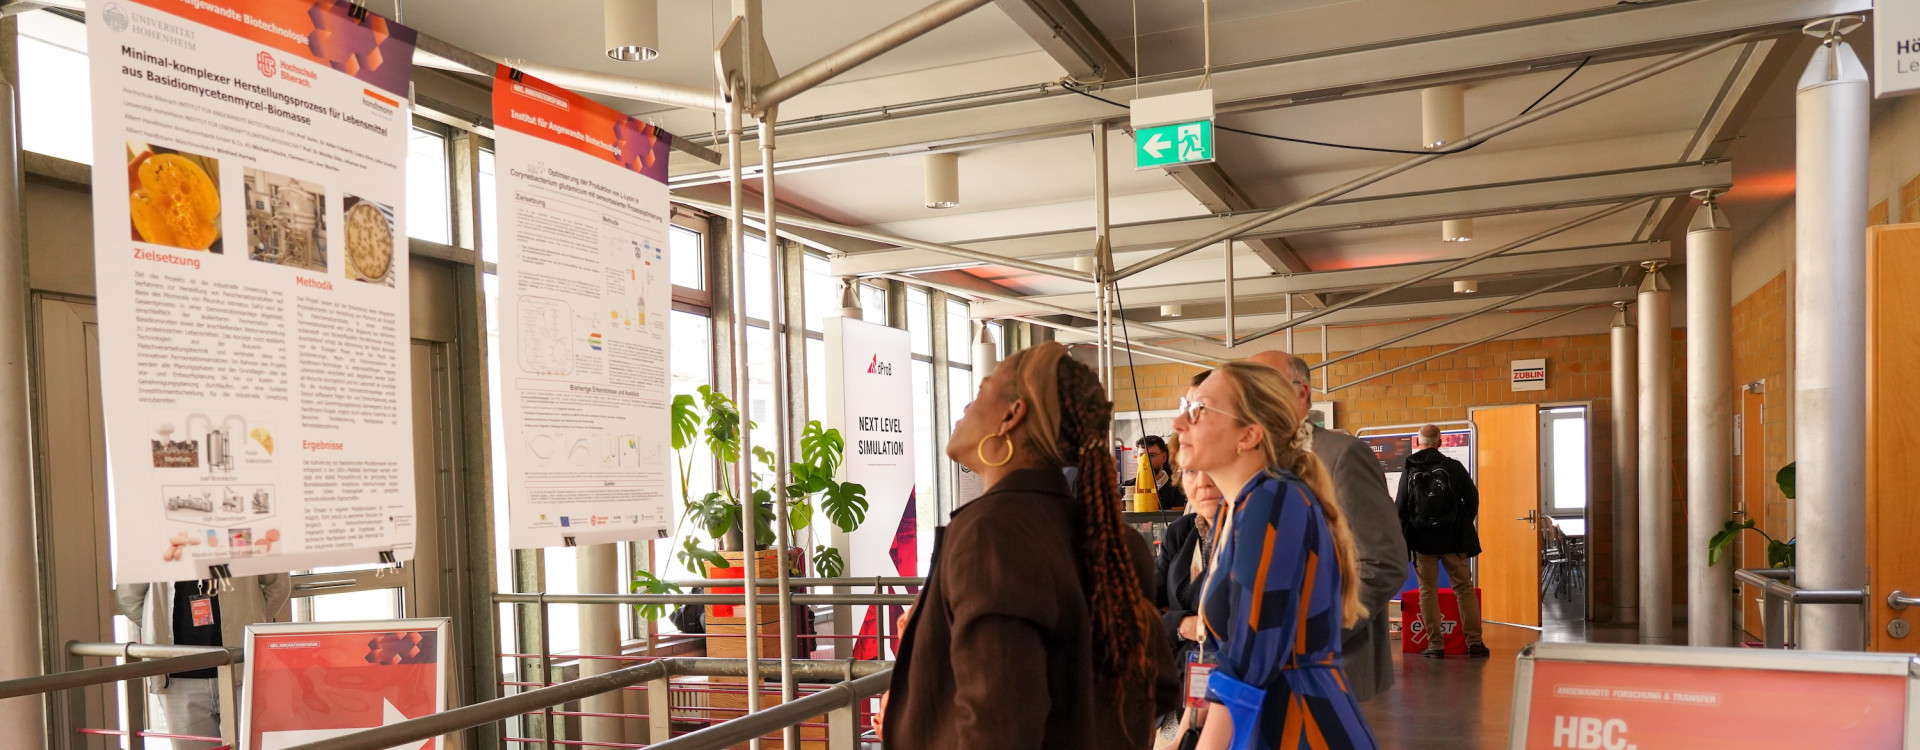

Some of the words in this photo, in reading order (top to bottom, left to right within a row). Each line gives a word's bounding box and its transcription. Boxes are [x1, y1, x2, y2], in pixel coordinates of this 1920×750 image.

[180, 0, 242, 21] ngewandte
[243, 13, 309, 45] Biotechnologie
[132, 24, 197, 51] HOHENHEIM
[280, 60, 318, 80] Hochschule
[122, 45, 231, 85] Minimal-komplexer
[234, 77, 327, 115] Herstellungsprozess
[329, 107, 341, 119] für
[342, 112, 388, 136] Lebensmittel
[122, 65, 143, 79] aus
[147, 70, 311, 125] Basidiomycetenmycel-Biomasse
[511, 109, 536, 125] Institut
[537, 117, 548, 129] für
[548, 121, 585, 141] Angewandte
[133, 248, 201, 270] Zielsetzung
[296, 276, 333, 291] Methodik
[858, 416, 879, 432] NEXT
[880, 417, 903, 433] LEVEL
[302, 439, 344, 452] Ergebnisse
[858, 440, 904, 456] SIMULATION
[1556, 686, 1609, 698] ANGEWANDTE
[1613, 689, 1661, 701] FORSCHUNG
[1664, 692, 1670, 701] &
[1672, 692, 1717, 704] TRANSFER
[1553, 715, 1637, 750] HBC.
